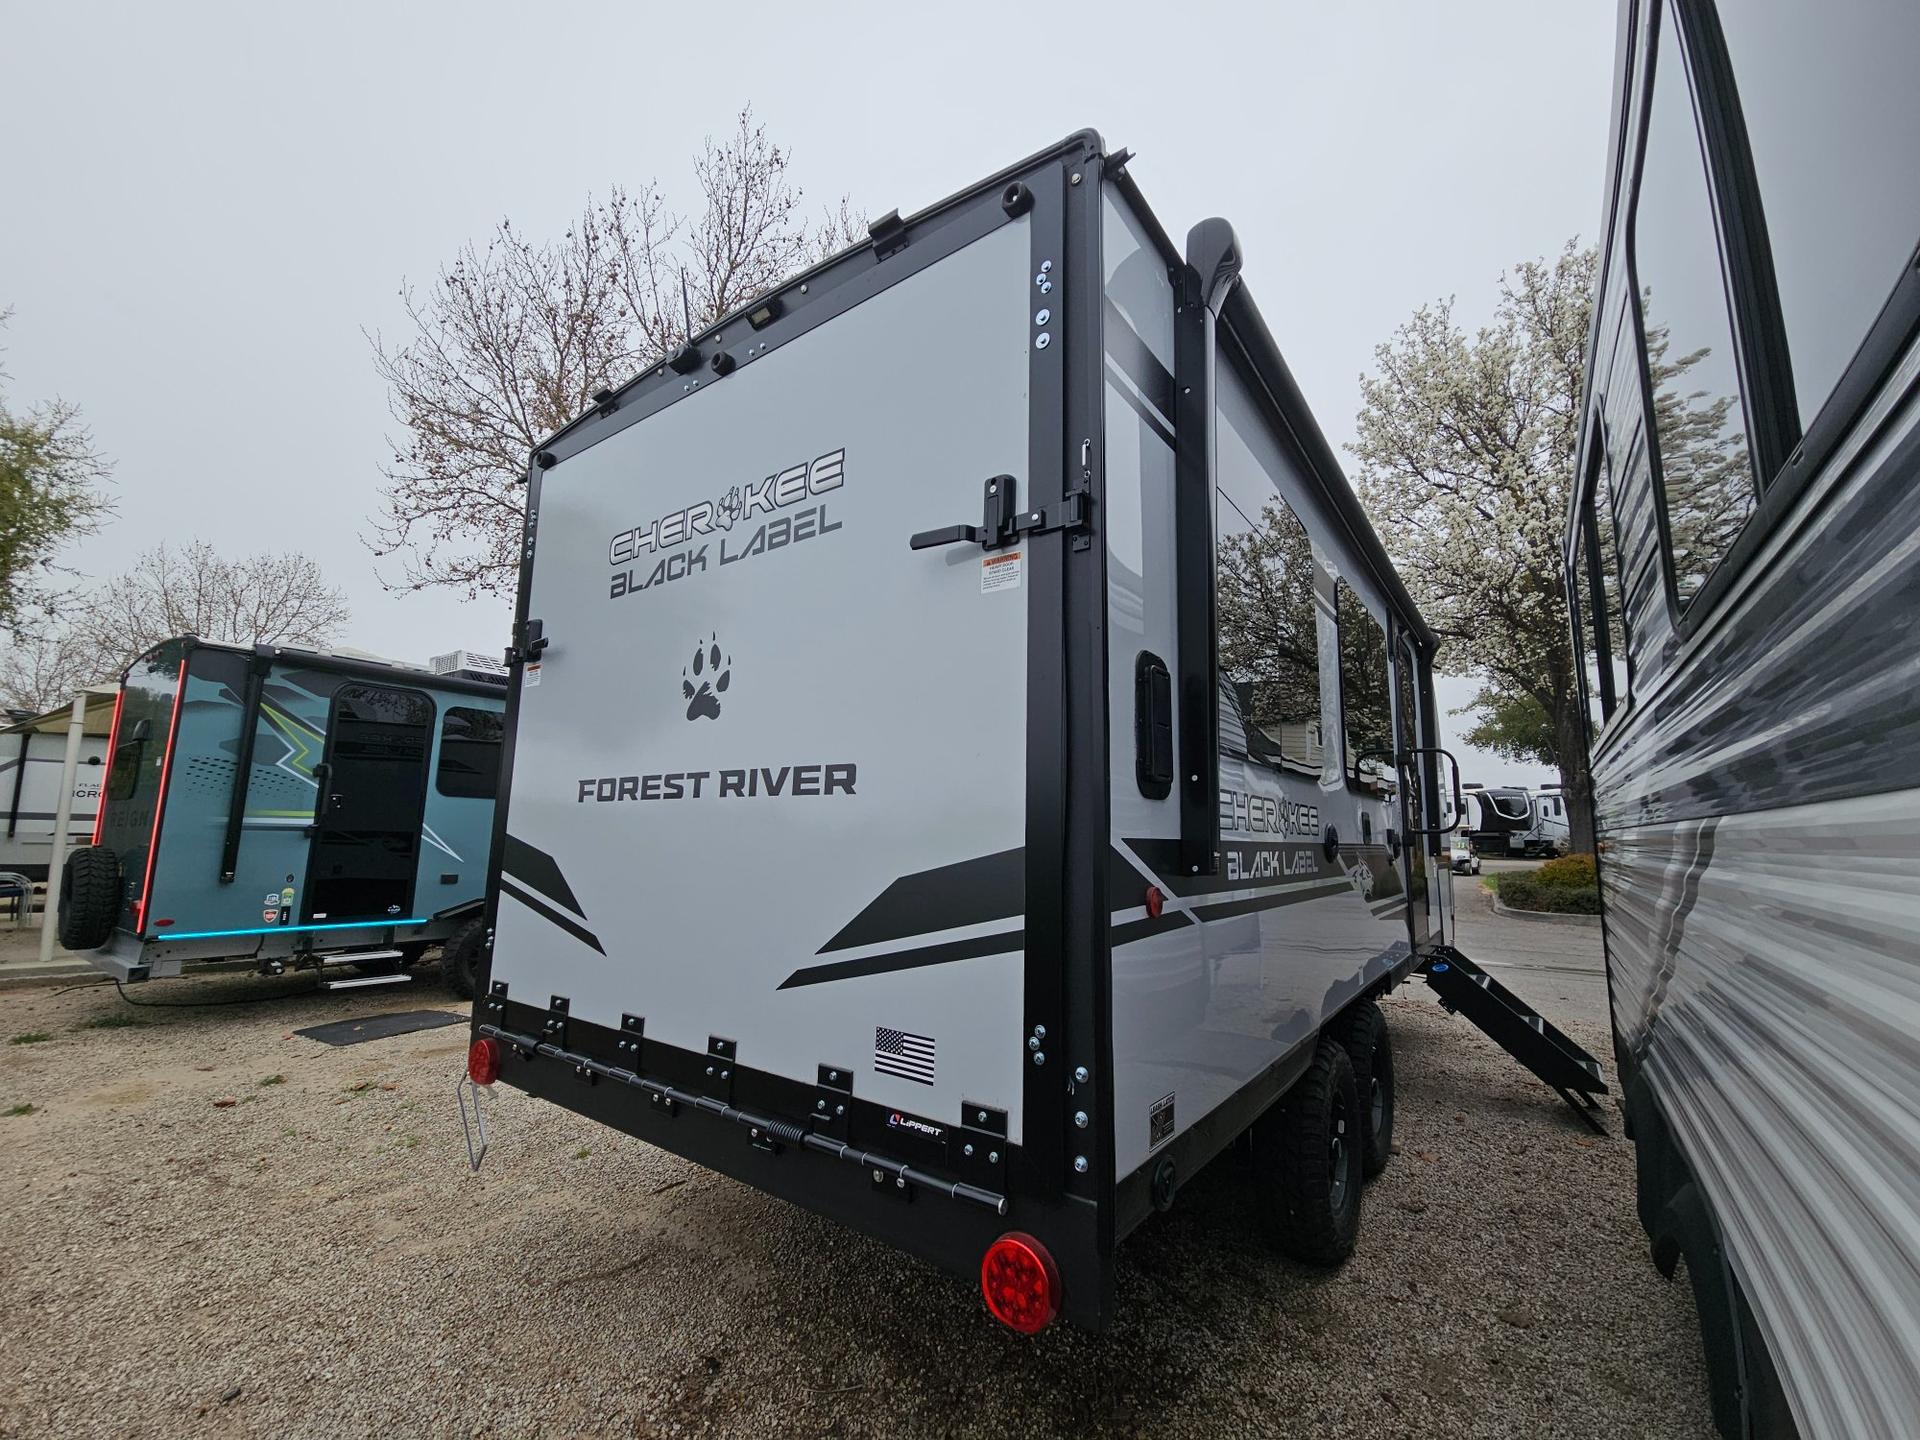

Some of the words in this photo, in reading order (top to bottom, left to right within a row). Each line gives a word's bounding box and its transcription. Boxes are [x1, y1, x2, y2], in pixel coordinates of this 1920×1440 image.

[609, 447, 845, 566] CHEROKEE
[609, 543, 709, 599] BLACK
[719, 504, 842, 566] LABEL
[578, 771, 710, 803] FOREST
[719, 763, 857, 798] RIVER
[1227, 851, 1280, 880] BLACK
[1283, 851, 1319, 875] LABEL
